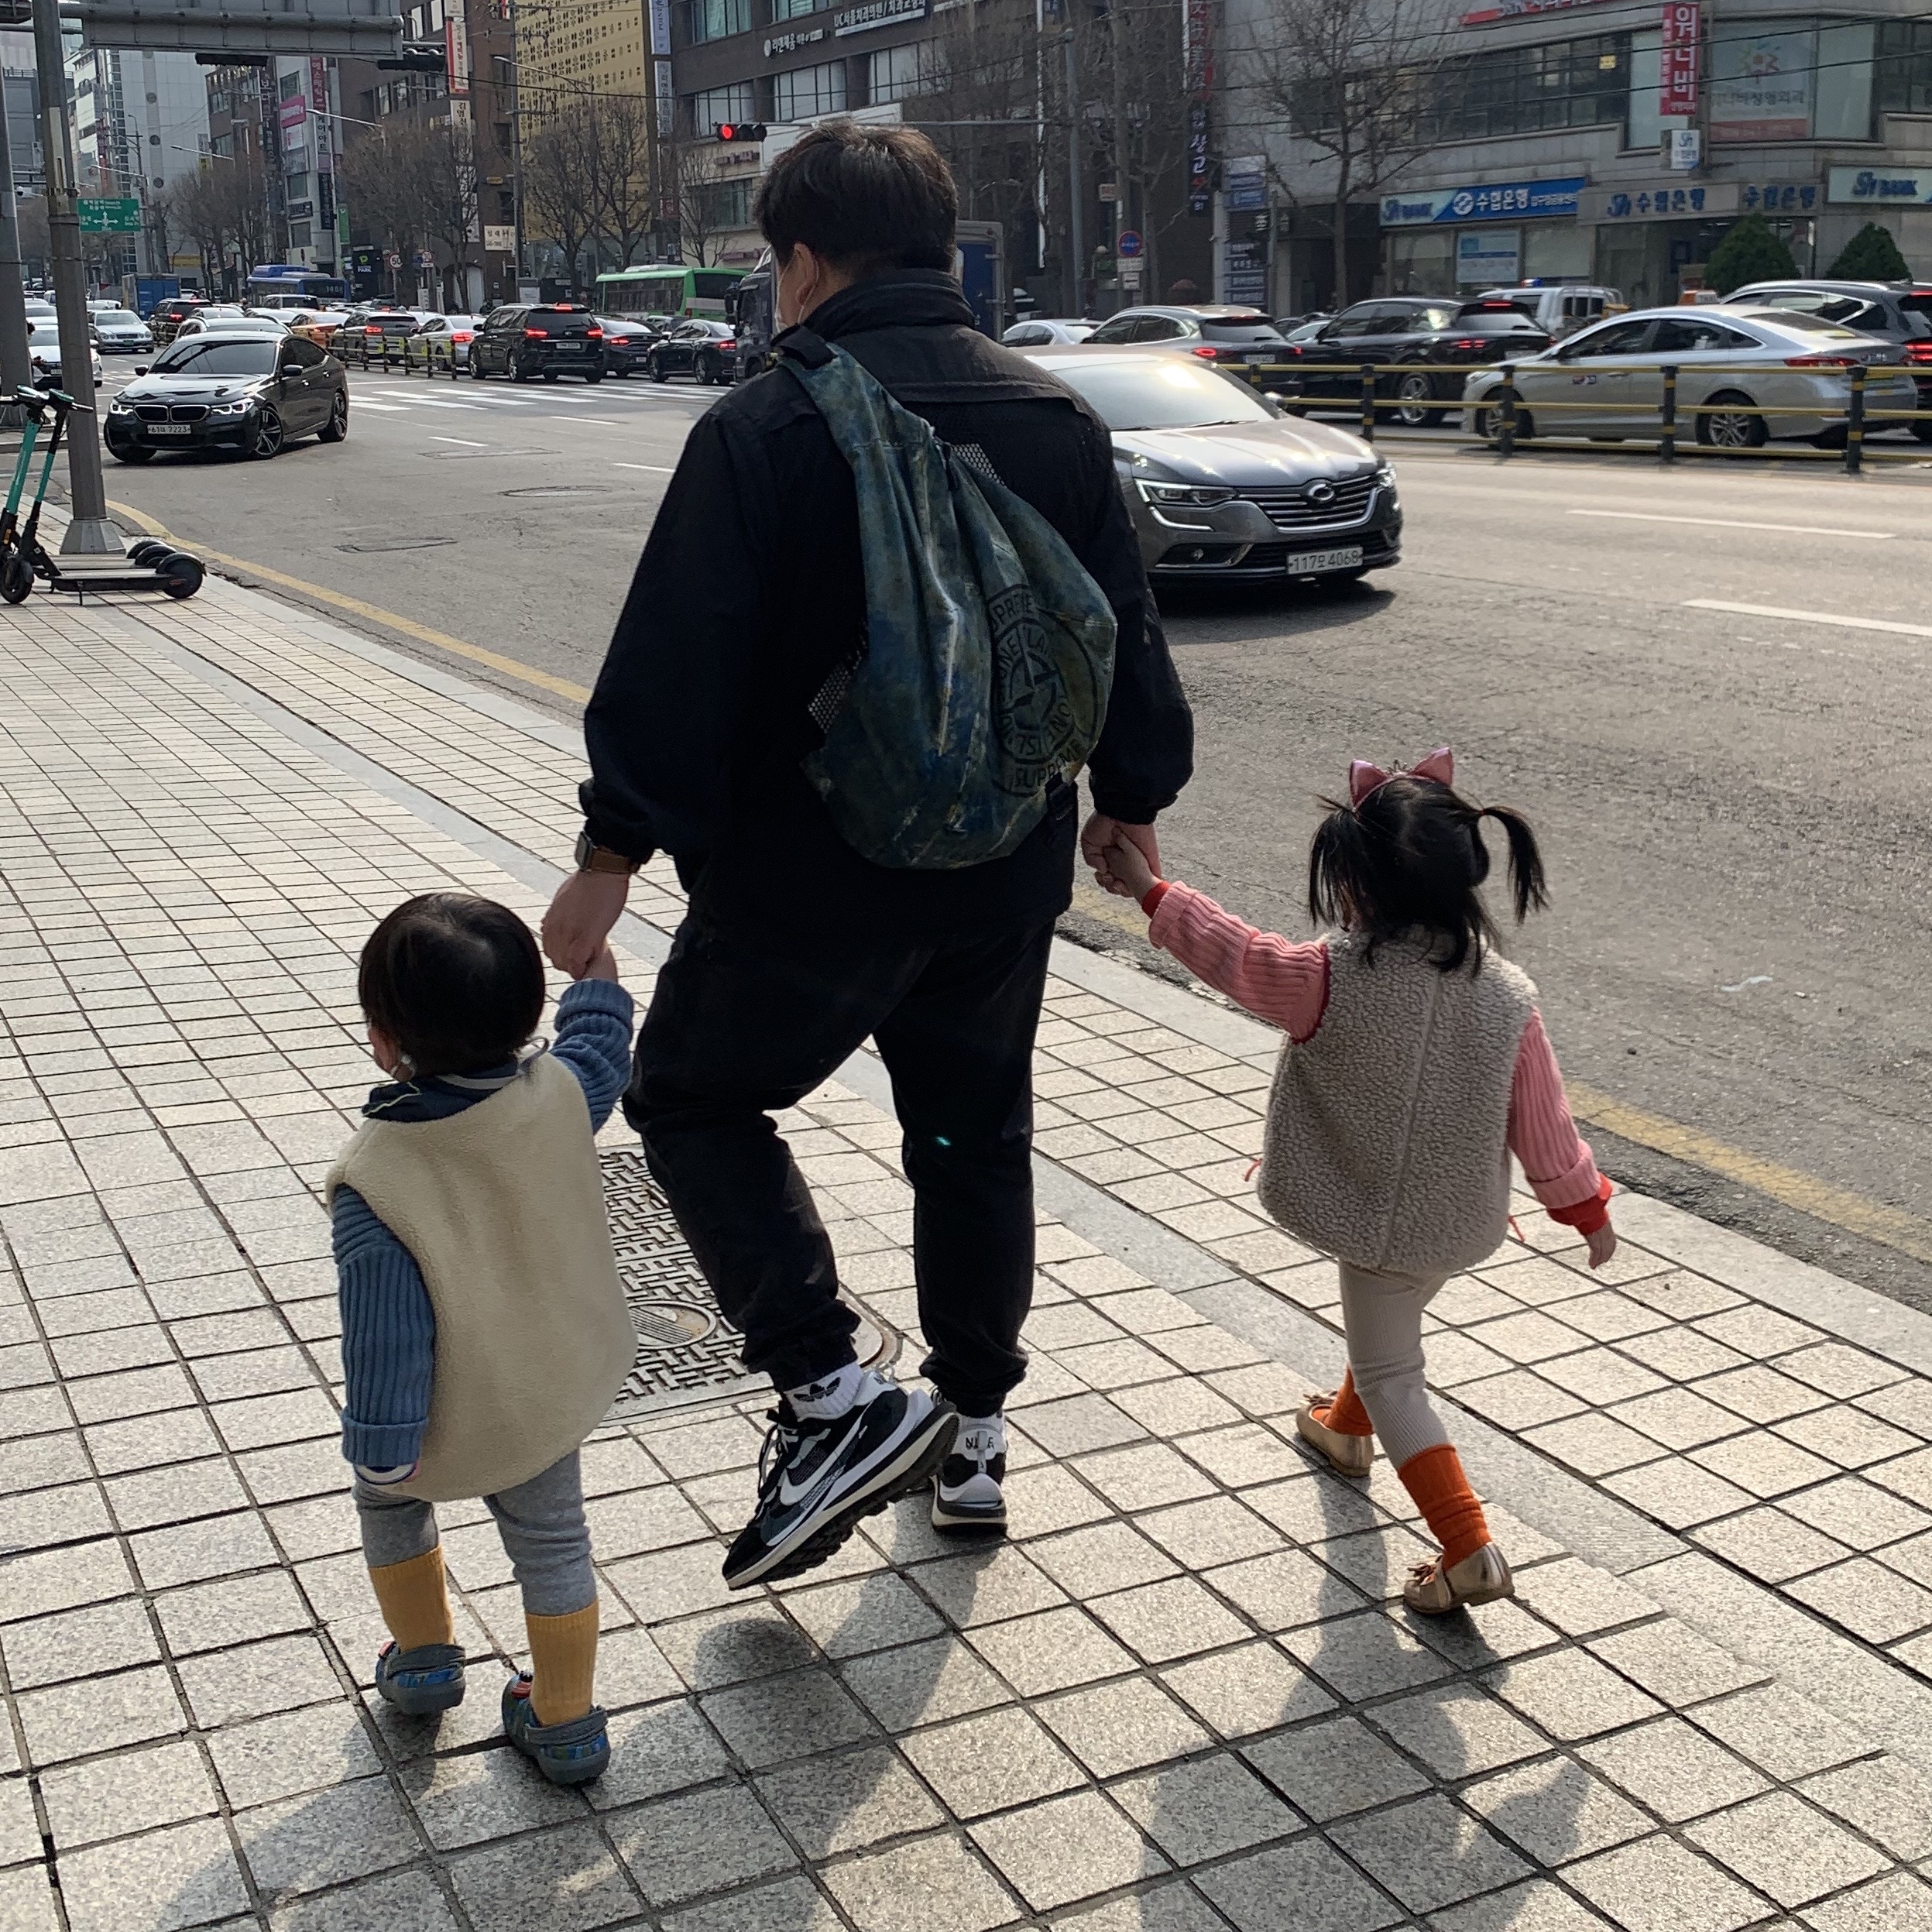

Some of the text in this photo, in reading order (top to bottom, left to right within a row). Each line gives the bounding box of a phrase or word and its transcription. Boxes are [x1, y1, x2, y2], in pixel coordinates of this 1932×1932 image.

[1674, 7, 1697, 101] 워너비
[1477, 188, 1529, 211] 수협은행
[393, 256, 402, 265] 50
[1328, 550, 1359, 566] 4068
